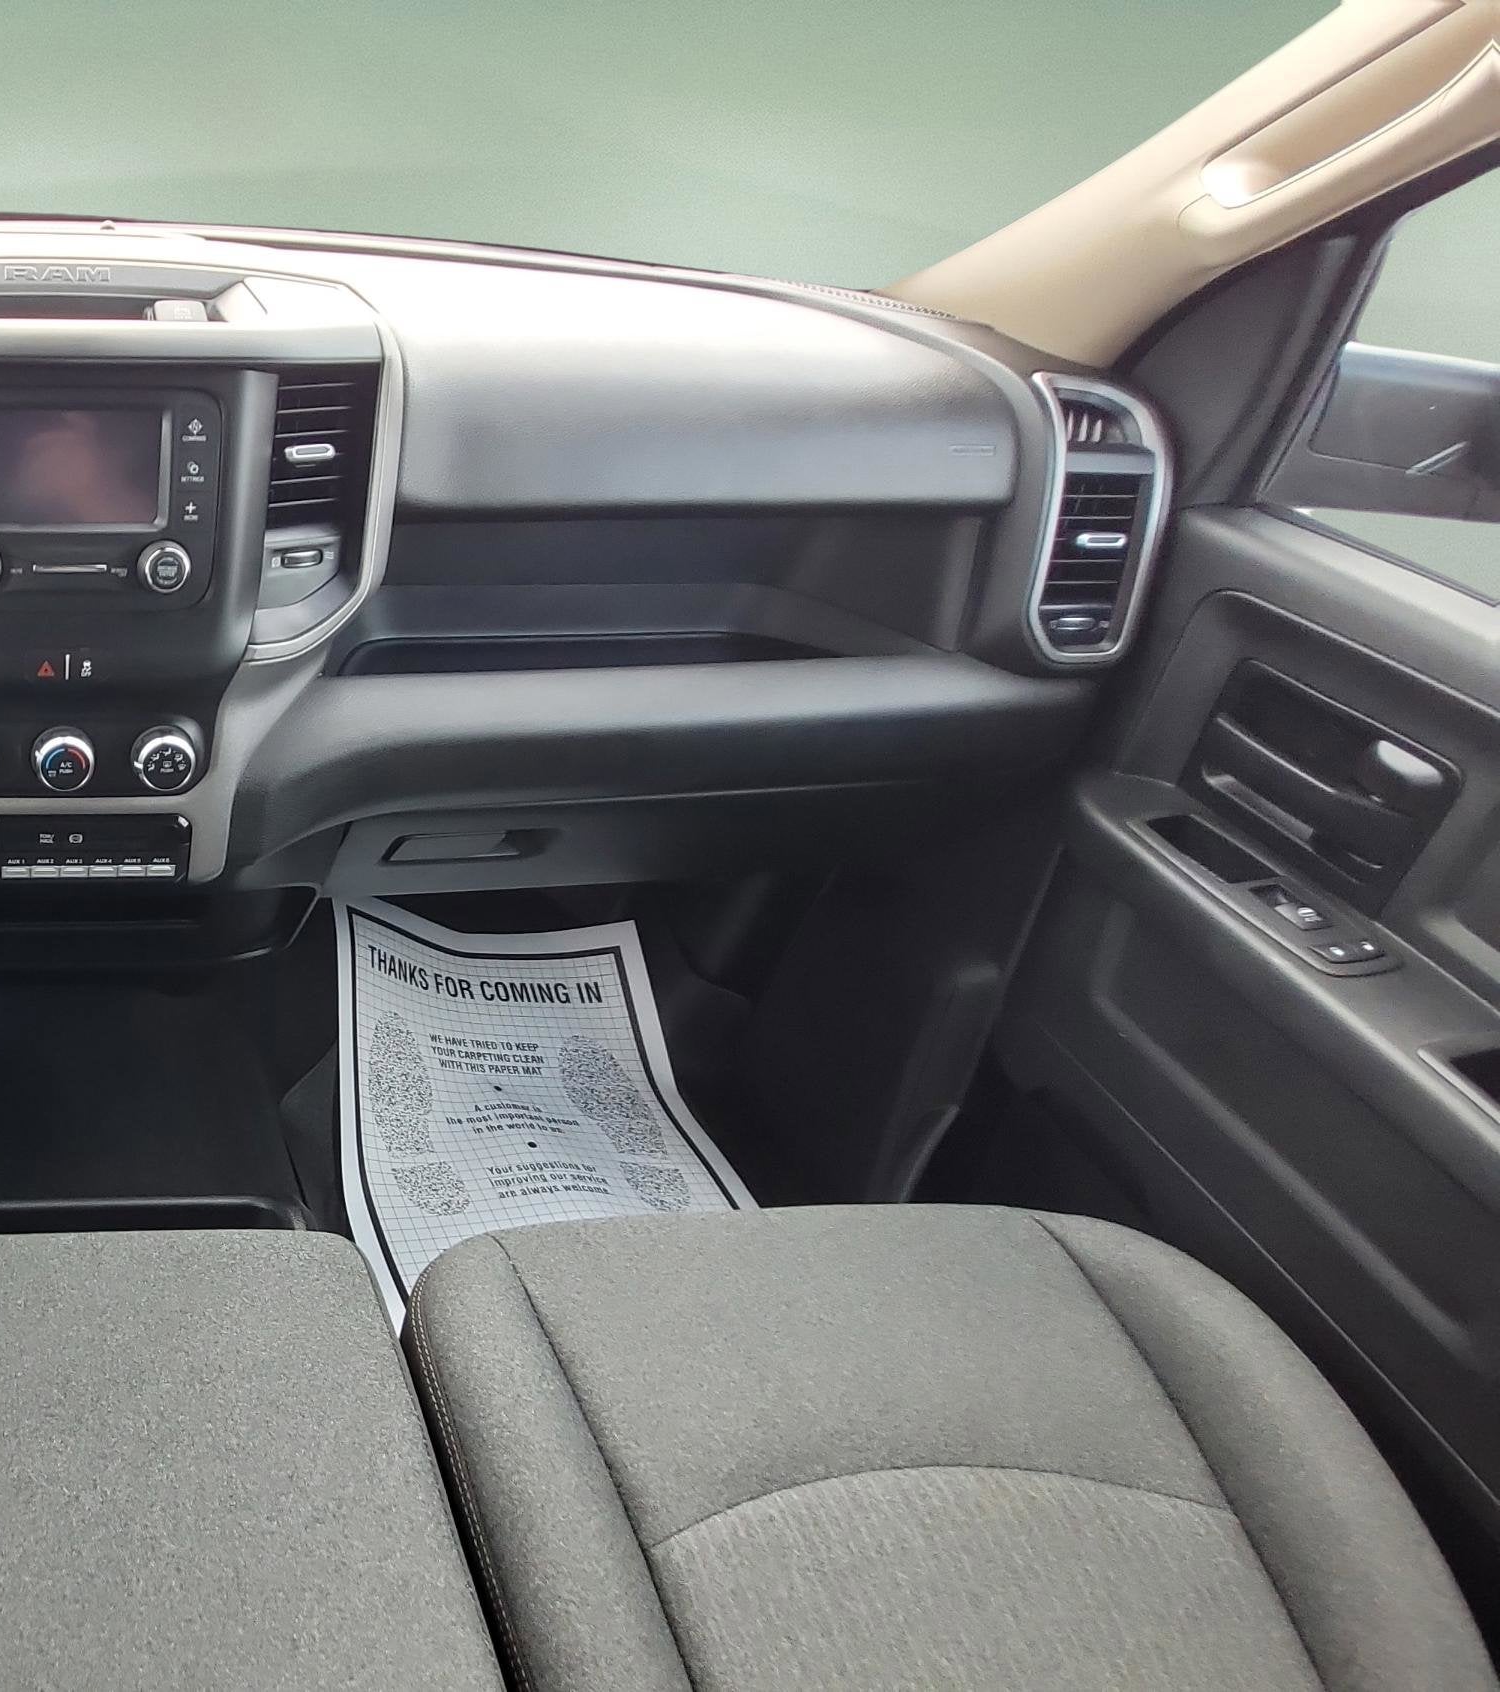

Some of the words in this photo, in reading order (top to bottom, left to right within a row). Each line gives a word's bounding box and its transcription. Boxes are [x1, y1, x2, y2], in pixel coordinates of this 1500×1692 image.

[4, 265, 111, 282] RAM
[367, 944, 429, 991] THANKS
[434, 973, 474, 1000] FOR
[479, 980, 572, 1004] COMING
[576, 981, 603, 1004] IN
[428, 1033, 442, 1044] WE
[444, 1036, 468, 1047] HAVE
[470, 1039, 498, 1050] TRIED
[500, 1041, 513, 1051] TO
[515, 1042, 539, 1052] KEEP
[431, 1046, 456, 1058] YOUR
[458, 1050, 511, 1062] CARPETING
[513, 1054, 545, 1064] CLEAN
[439, 1058, 464, 1071] WITH
[464, 1062, 486, 1073] THIS
[488, 1064, 520, 1075] PAPER
[522, 1066, 543, 1075] MAT
[474, 1104, 483, 1112] A
[484, 1102, 530, 1111] customer
[533, 1104, 542, 1112] is
[445, 1116, 463, 1125] the
[466, 1114, 493, 1124] most
[494, 1112, 545, 1121] important
[473, 1126, 484, 1134] in
[486, 1124, 504, 1132] the
[506, 1121, 536, 1130] world
[537, 1123, 548, 1131] to
[487, 1165, 513, 1175] Your
[516, 1160, 581, 1171] suggestions
[582, 1163, 597, 1173] for
[488, 1173, 548, 1187] improving
[550, 1172, 568, 1180] our
[570, 1173, 610, 1185] service
[499, 1189, 518, 1199] are
[520, 1184, 560, 1196] always
